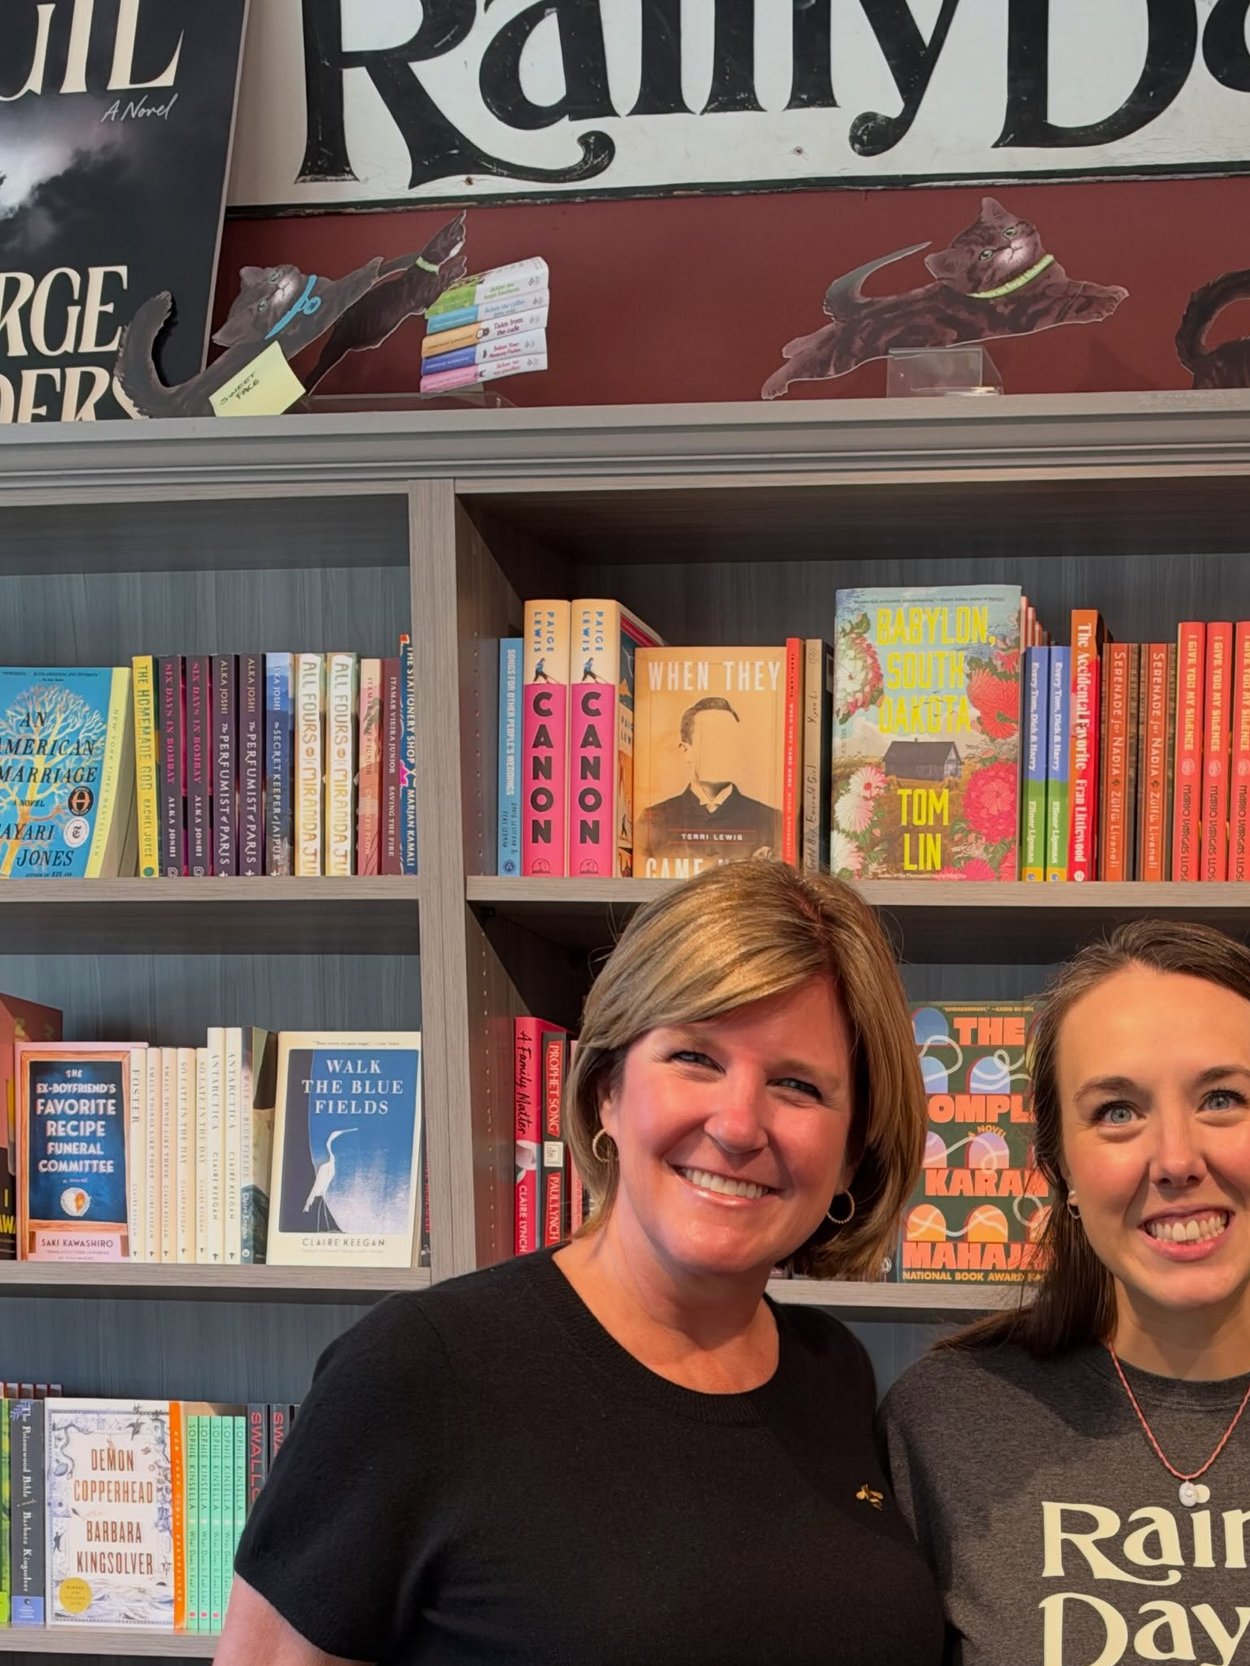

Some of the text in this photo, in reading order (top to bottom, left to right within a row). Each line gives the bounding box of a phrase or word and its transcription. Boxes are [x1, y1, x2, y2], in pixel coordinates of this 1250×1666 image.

[101, 94, 178, 122] A Novel
[876, 606, 995, 646] BABYLON,
[648, 661, 781, 692] WHEN THEY
[886, 653, 964, 689] SOUTH
[20, 712, 48, 728] AN
[878, 696, 972, 734] DAKOTA
[218, 659, 231, 865] ALKA JOSHI PERFUMIST PARIS
[531, 692, 554, 844] CANON
[0, 766, 98, 784] MARRIAGE
[899, 789, 950, 826] TOM
[0, 823, 54, 841] AYARI
[17, 849, 74, 866] JONES
[902, 834, 941, 871] LIN
[953, 1018, 1025, 1046] THE
[65, 1069, 84, 1078] THE
[326, 1059, 382, 1074] WALK
[36, 1083, 116, 1094] EX-BOYFRIEND'S
[301, 1079, 403, 1094] THE BLUE
[35, 1099, 116, 1116] FAVORITE
[314, 1100, 390, 1115] FIELDS
[47, 1120, 106, 1138] RECIPE
[976, 1124, 1007, 1138] NOVEL
[47, 1142, 104, 1156] FUNERAL
[38, 1159, 114, 1174] COMMITTEE
[41, 1238, 113, 1248] SAKI KAWASHIRO
[301, 1238, 385, 1248] CLAIRE KEEGAN
[902, 1241, 1054, 1271] MAHAJA
[903, 1272, 1024, 1282] NATIONAL BOOK AWARD
[91, 1448, 134, 1472] DEMON
[74, 1481, 153, 1504] COPPERHEAD
[86, 1521, 142, 1544] BARBARA
[76, 1553, 153, 1575] KINGSOLVER
